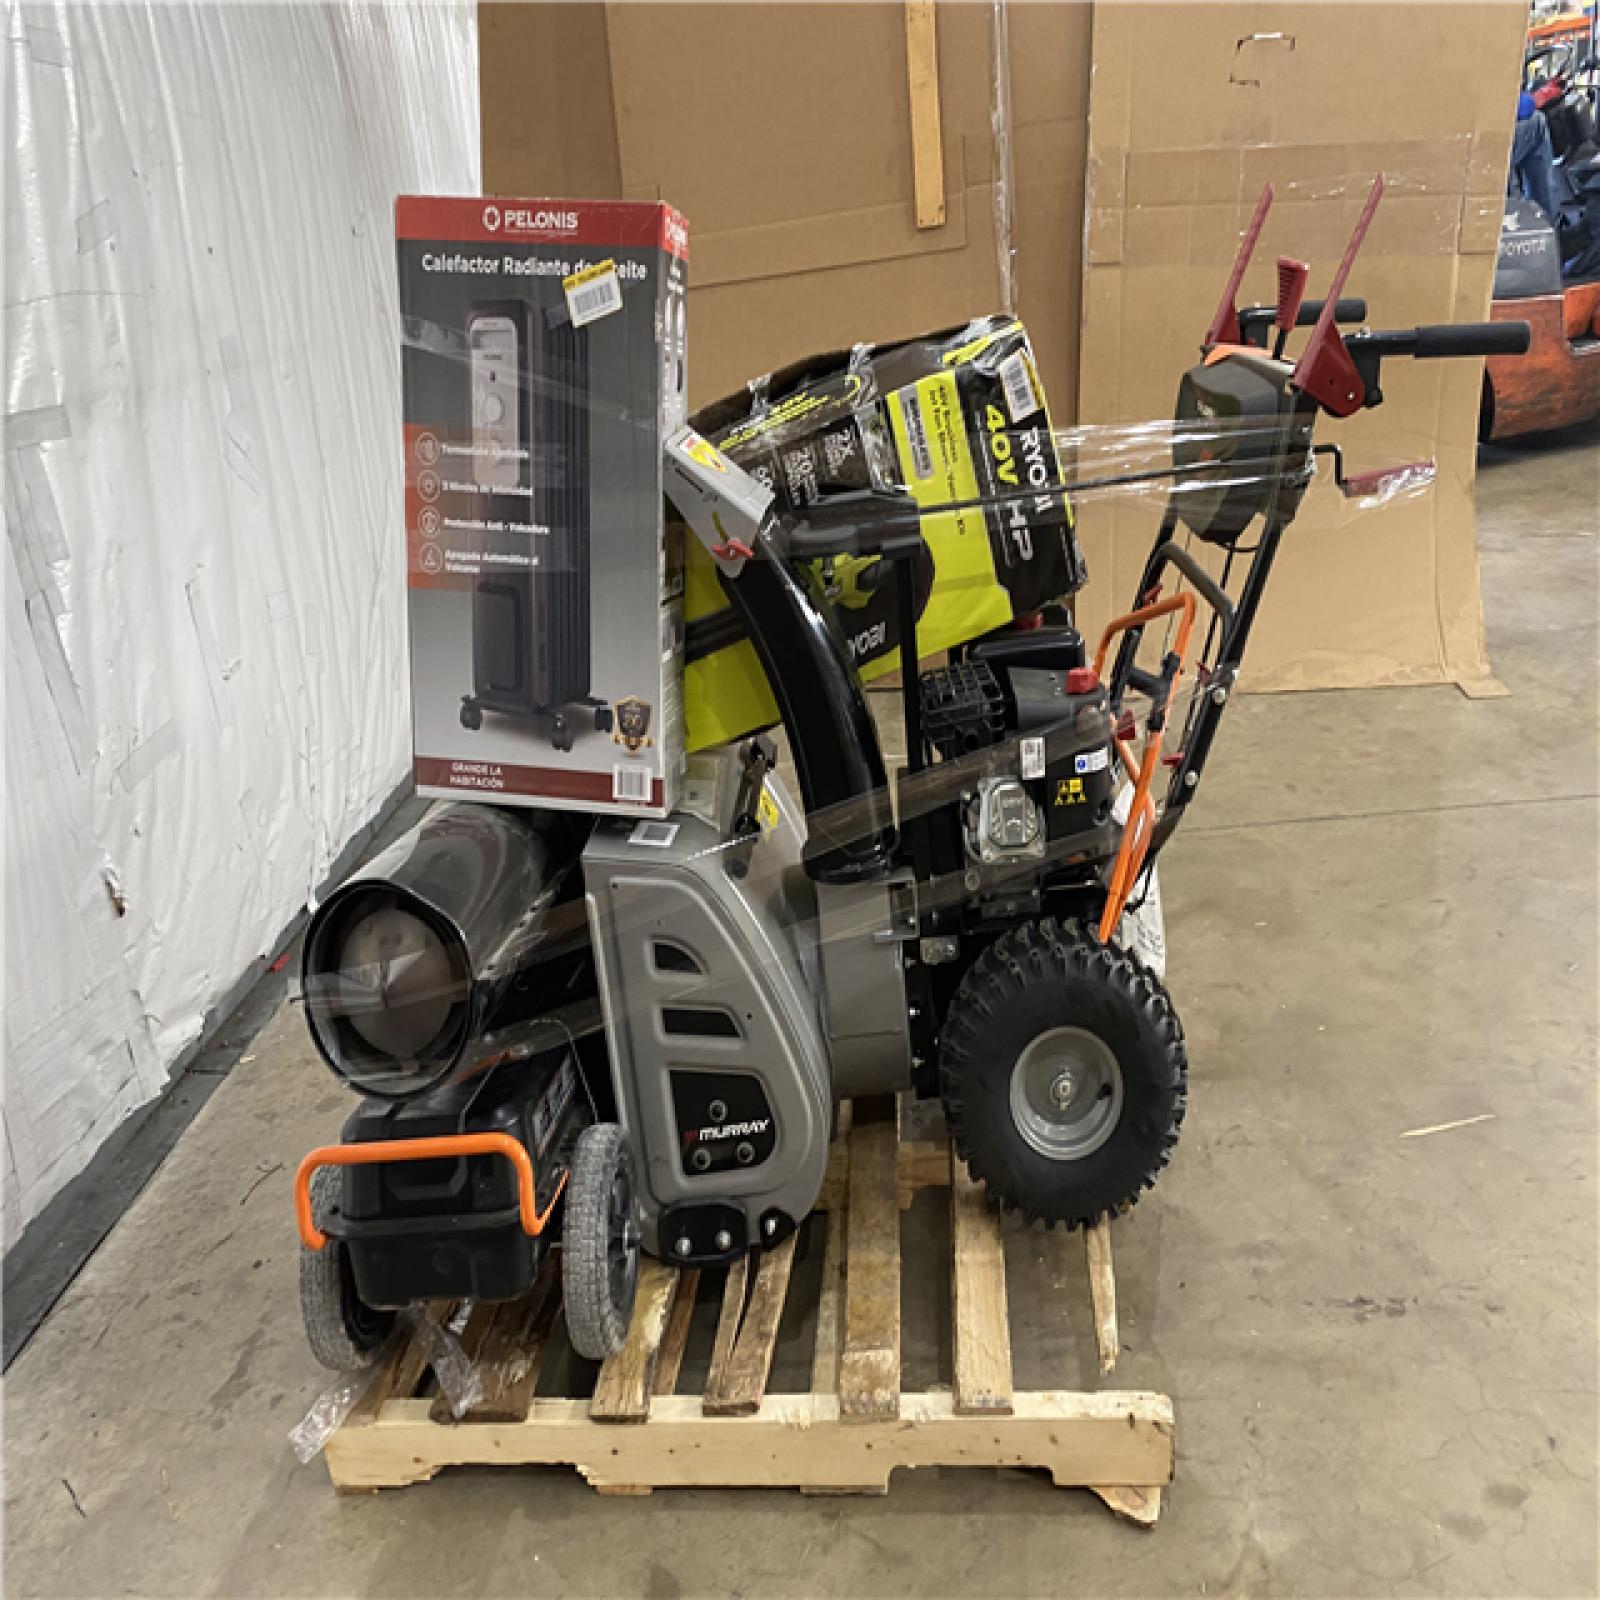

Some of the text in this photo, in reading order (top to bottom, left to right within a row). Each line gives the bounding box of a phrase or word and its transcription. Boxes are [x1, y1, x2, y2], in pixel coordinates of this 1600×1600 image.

[504, 209, 578, 229] PELONIS
[421, 253, 500, 273] Calefactor
[503, 256, 571, 276] Radiante
[614, 259, 648, 280] eite
[987, 404, 1018, 486] 40V
[1006, 499, 1034, 561] HP
[846, 621, 886, 660] YOBI
[490, 765, 504, 776] LA
[700, 1118, 770, 1140] MURRAY
